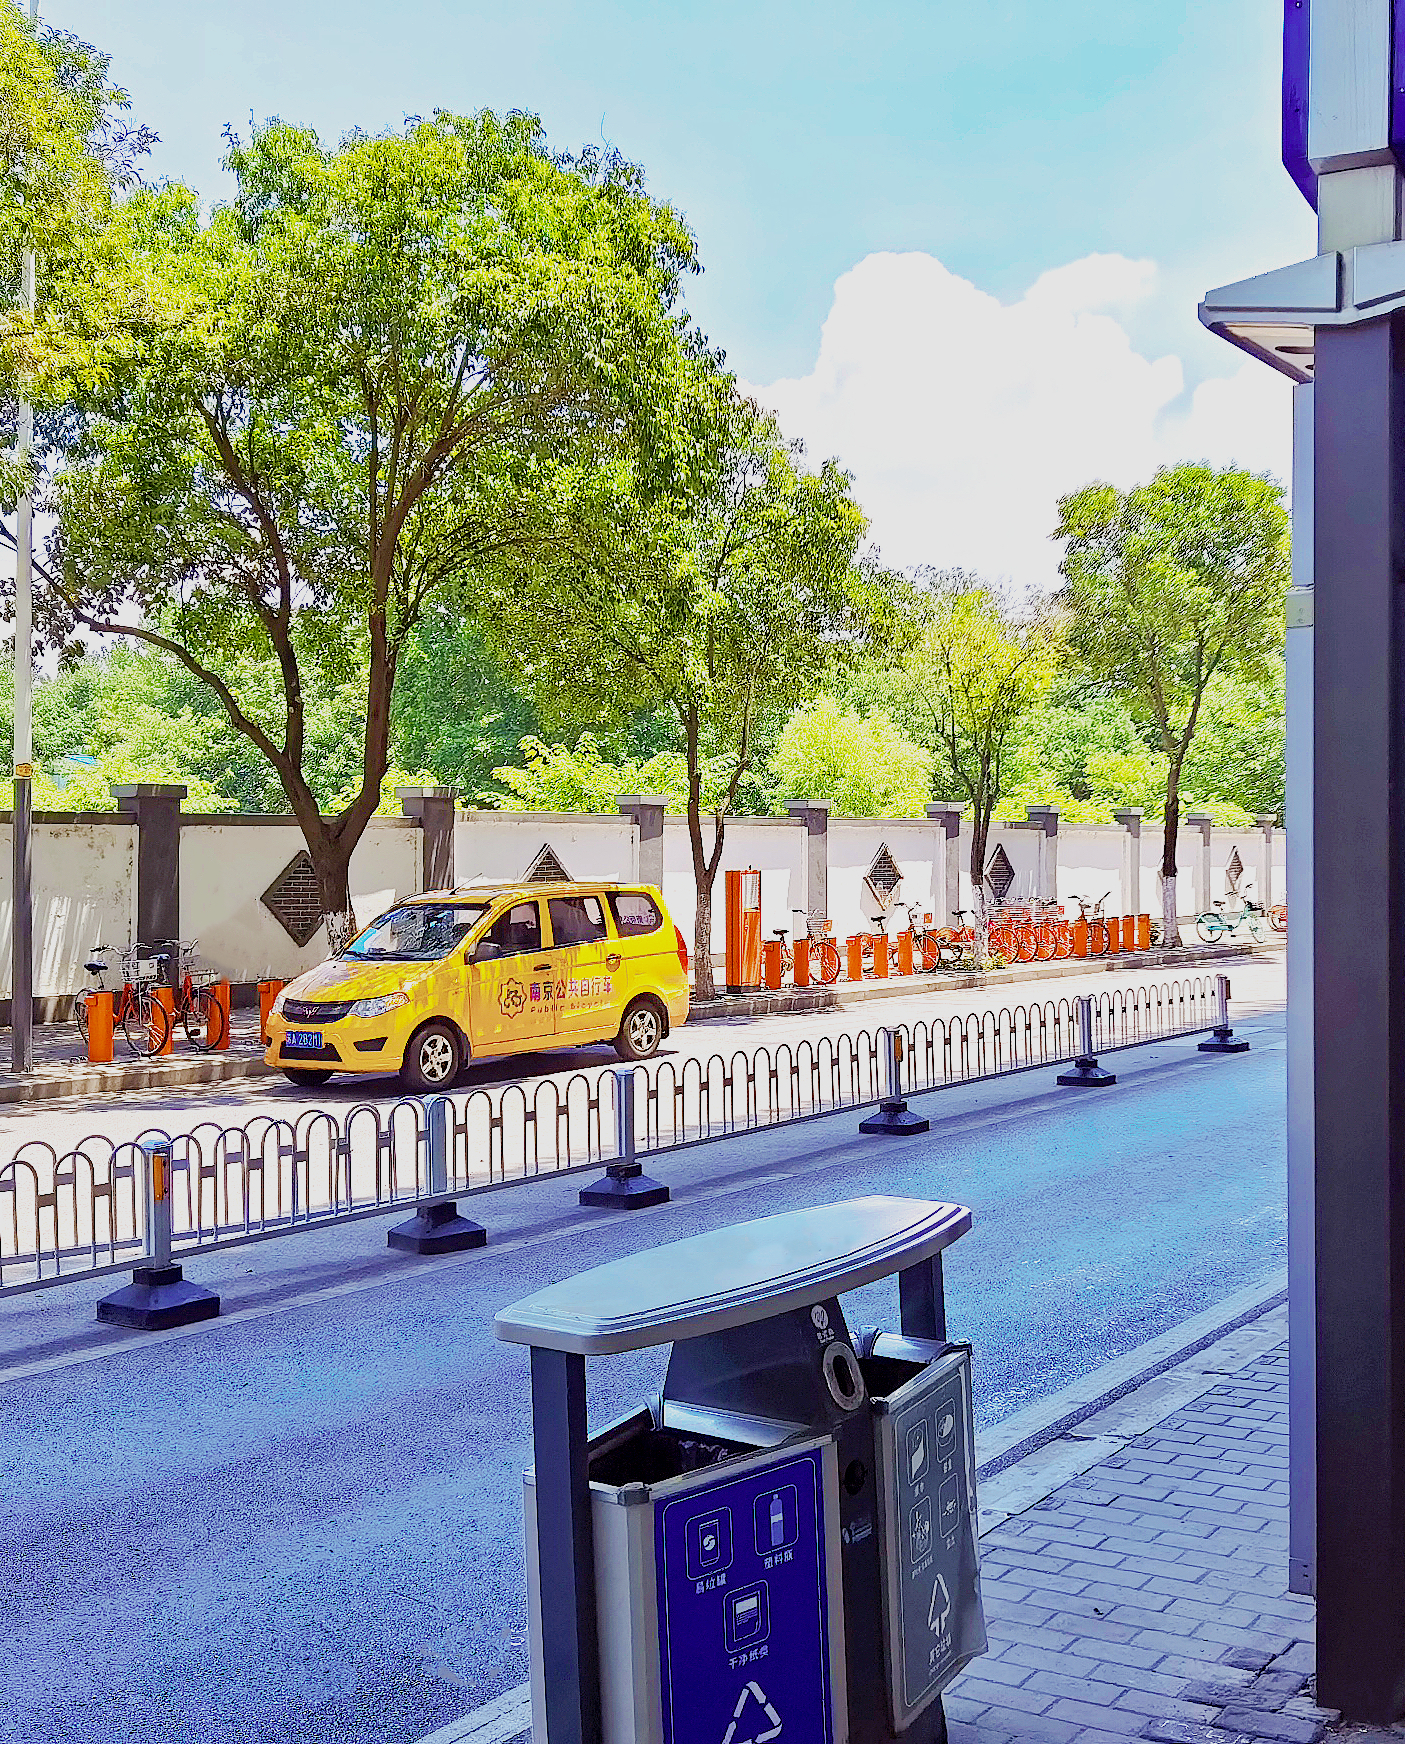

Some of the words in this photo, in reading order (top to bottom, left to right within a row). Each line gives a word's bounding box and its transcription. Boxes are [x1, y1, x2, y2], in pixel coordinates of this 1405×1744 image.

[529, 975, 613, 1002] 南京公共自行车
[764, 1549, 794, 1570] 塑料瓶
